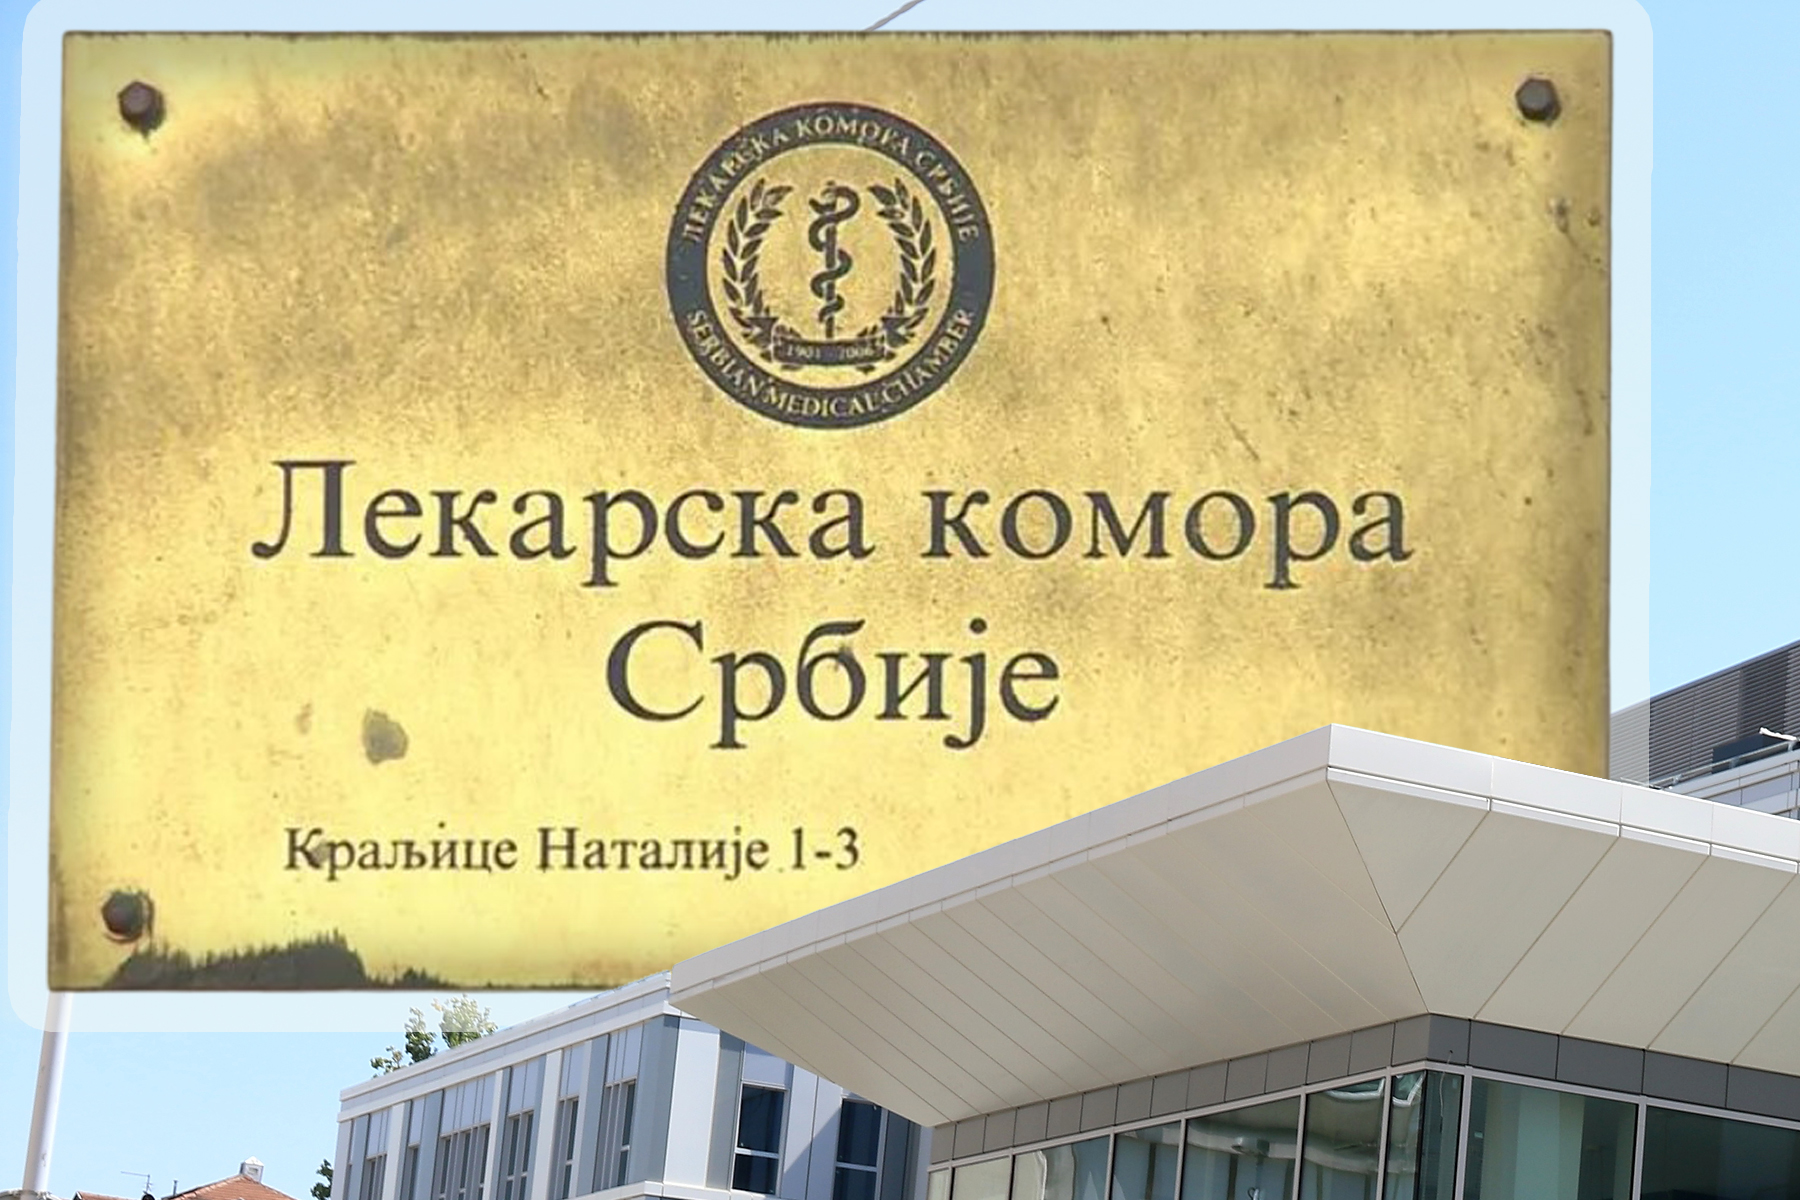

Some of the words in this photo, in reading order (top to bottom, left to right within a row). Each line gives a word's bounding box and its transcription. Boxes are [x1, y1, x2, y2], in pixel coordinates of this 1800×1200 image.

[683, 128, 789, 242] ЛЕКАРСКА
[797, 113, 910, 155] КОМОРА
[916, 148, 979, 242] СРБИЈЕ
[686, 309, 765, 397] SERBIAN
[762, 386, 880, 418] MEDICAL
[880, 309, 975, 405] CHAMBER
[252, 460, 875, 588] Лекарска
[921, 489, 1413, 590] комора
[606, 618, 1060, 750] Србије
[285, 827, 518, 880] Краљице
[537, 827, 769, 881] Наталије
[790, 827, 860, 870] 1-3
